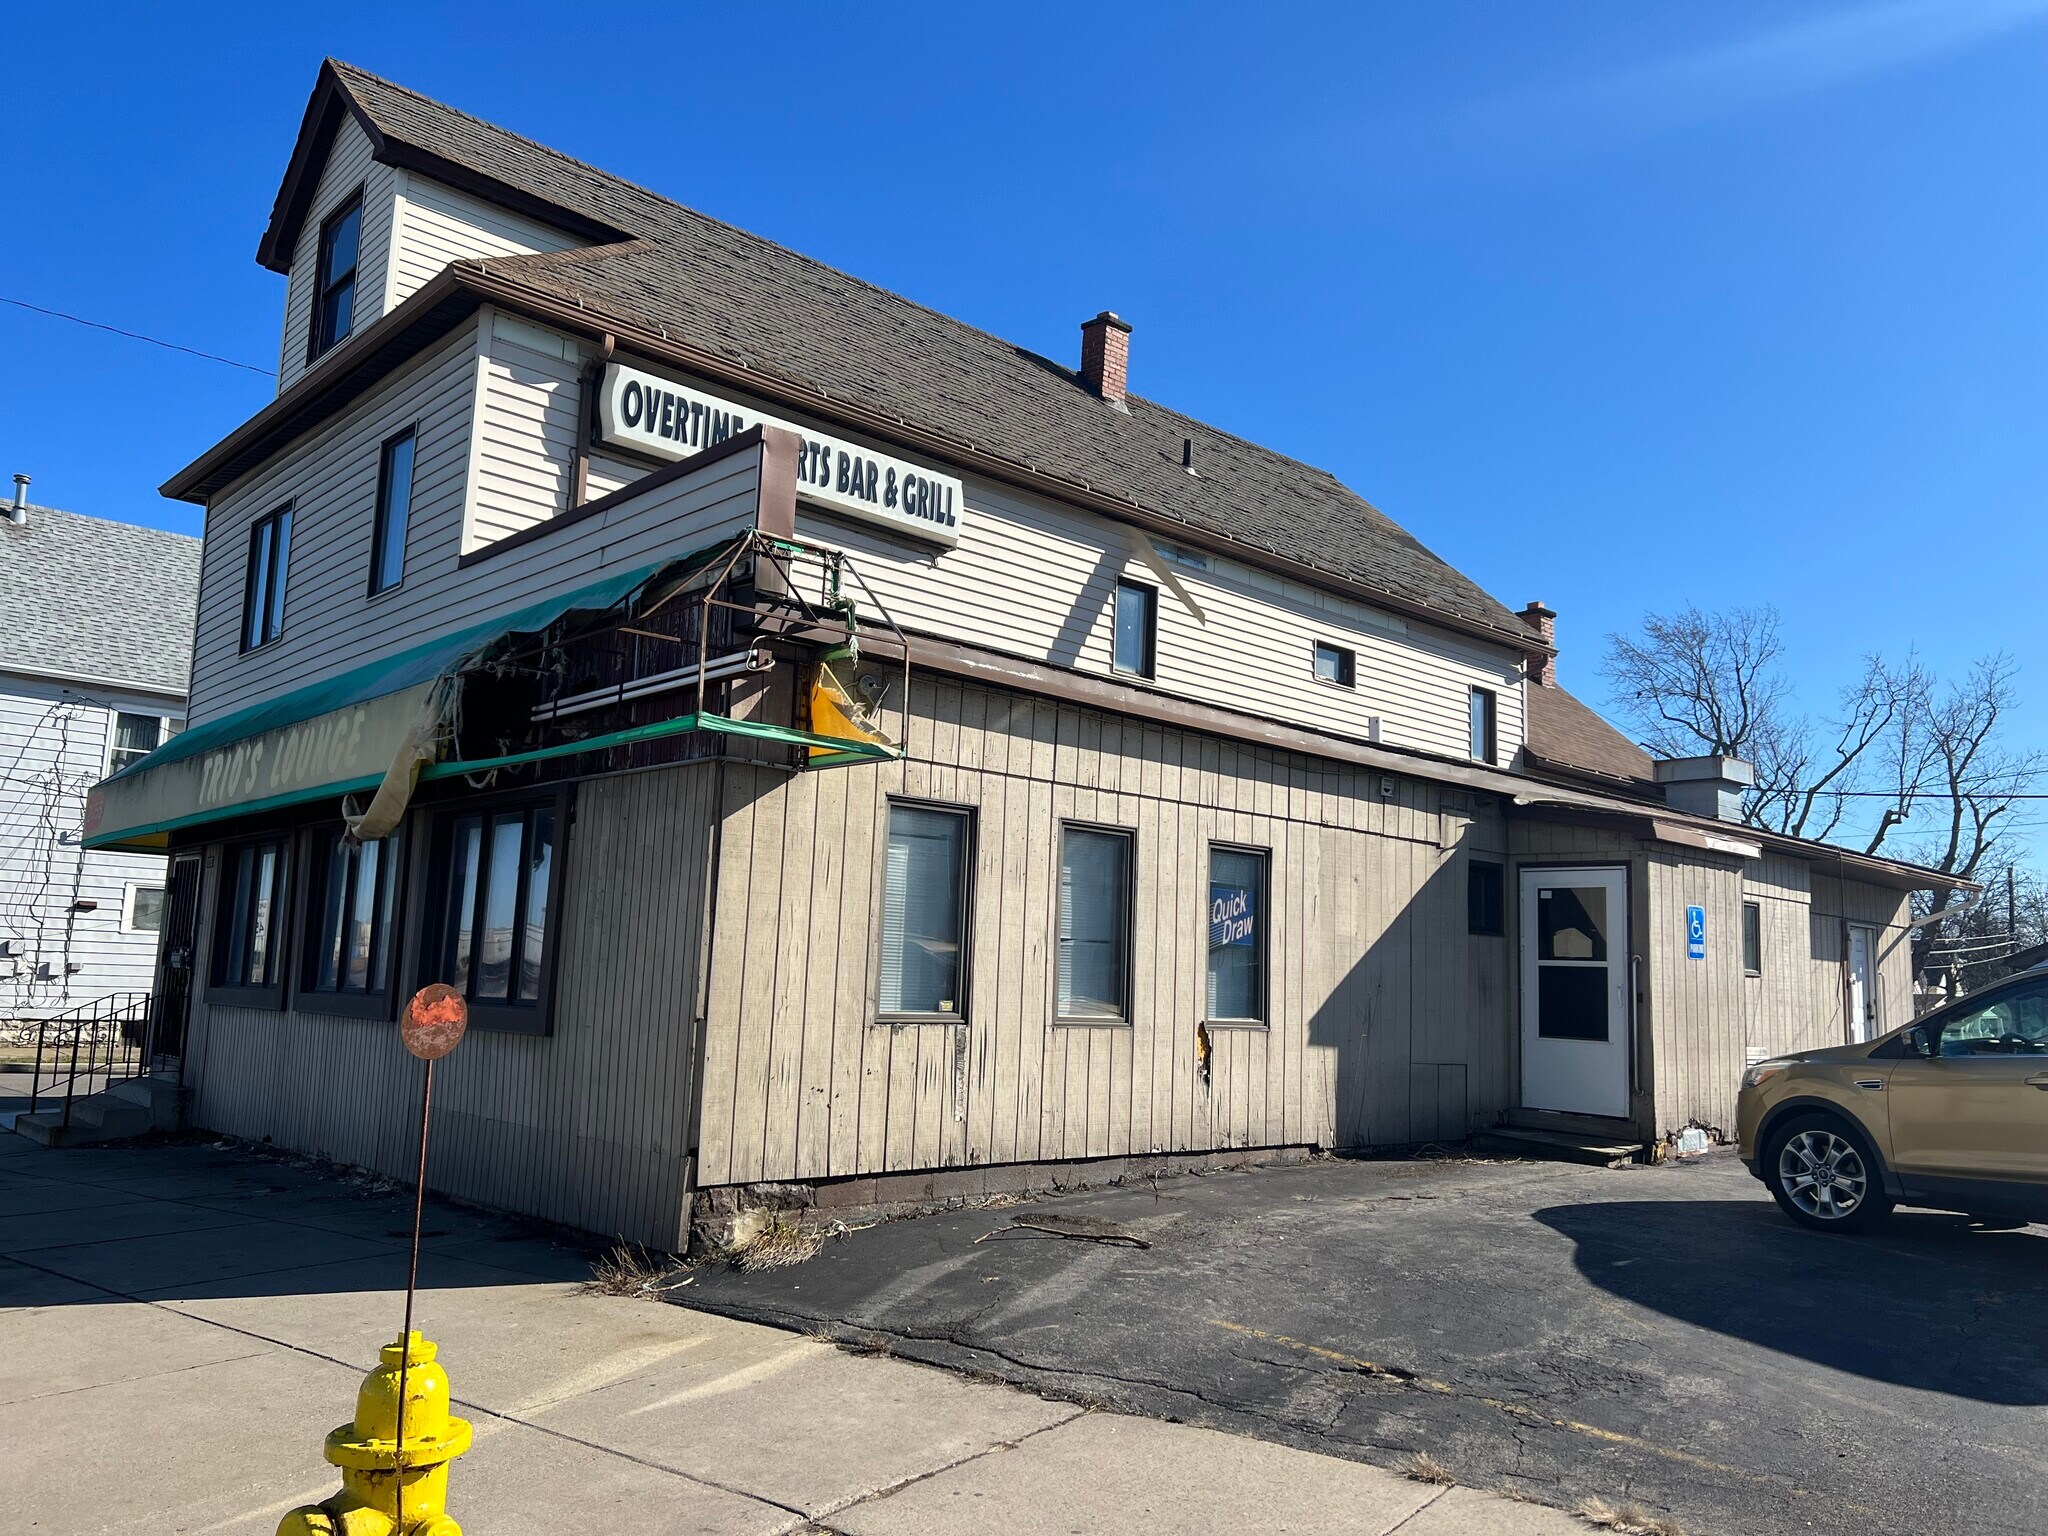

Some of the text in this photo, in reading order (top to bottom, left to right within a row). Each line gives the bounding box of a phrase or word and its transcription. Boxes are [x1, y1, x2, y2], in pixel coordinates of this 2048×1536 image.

[836, 450, 878, 504] BAR
[884, 466, 899, 509] &
[903, 473, 955, 526] GRILL
[200, 711, 365, 805] TRIO'S LOUNGE
[1213, 889, 1247, 923] Quick
[1222, 915, 1253, 945] Draw
